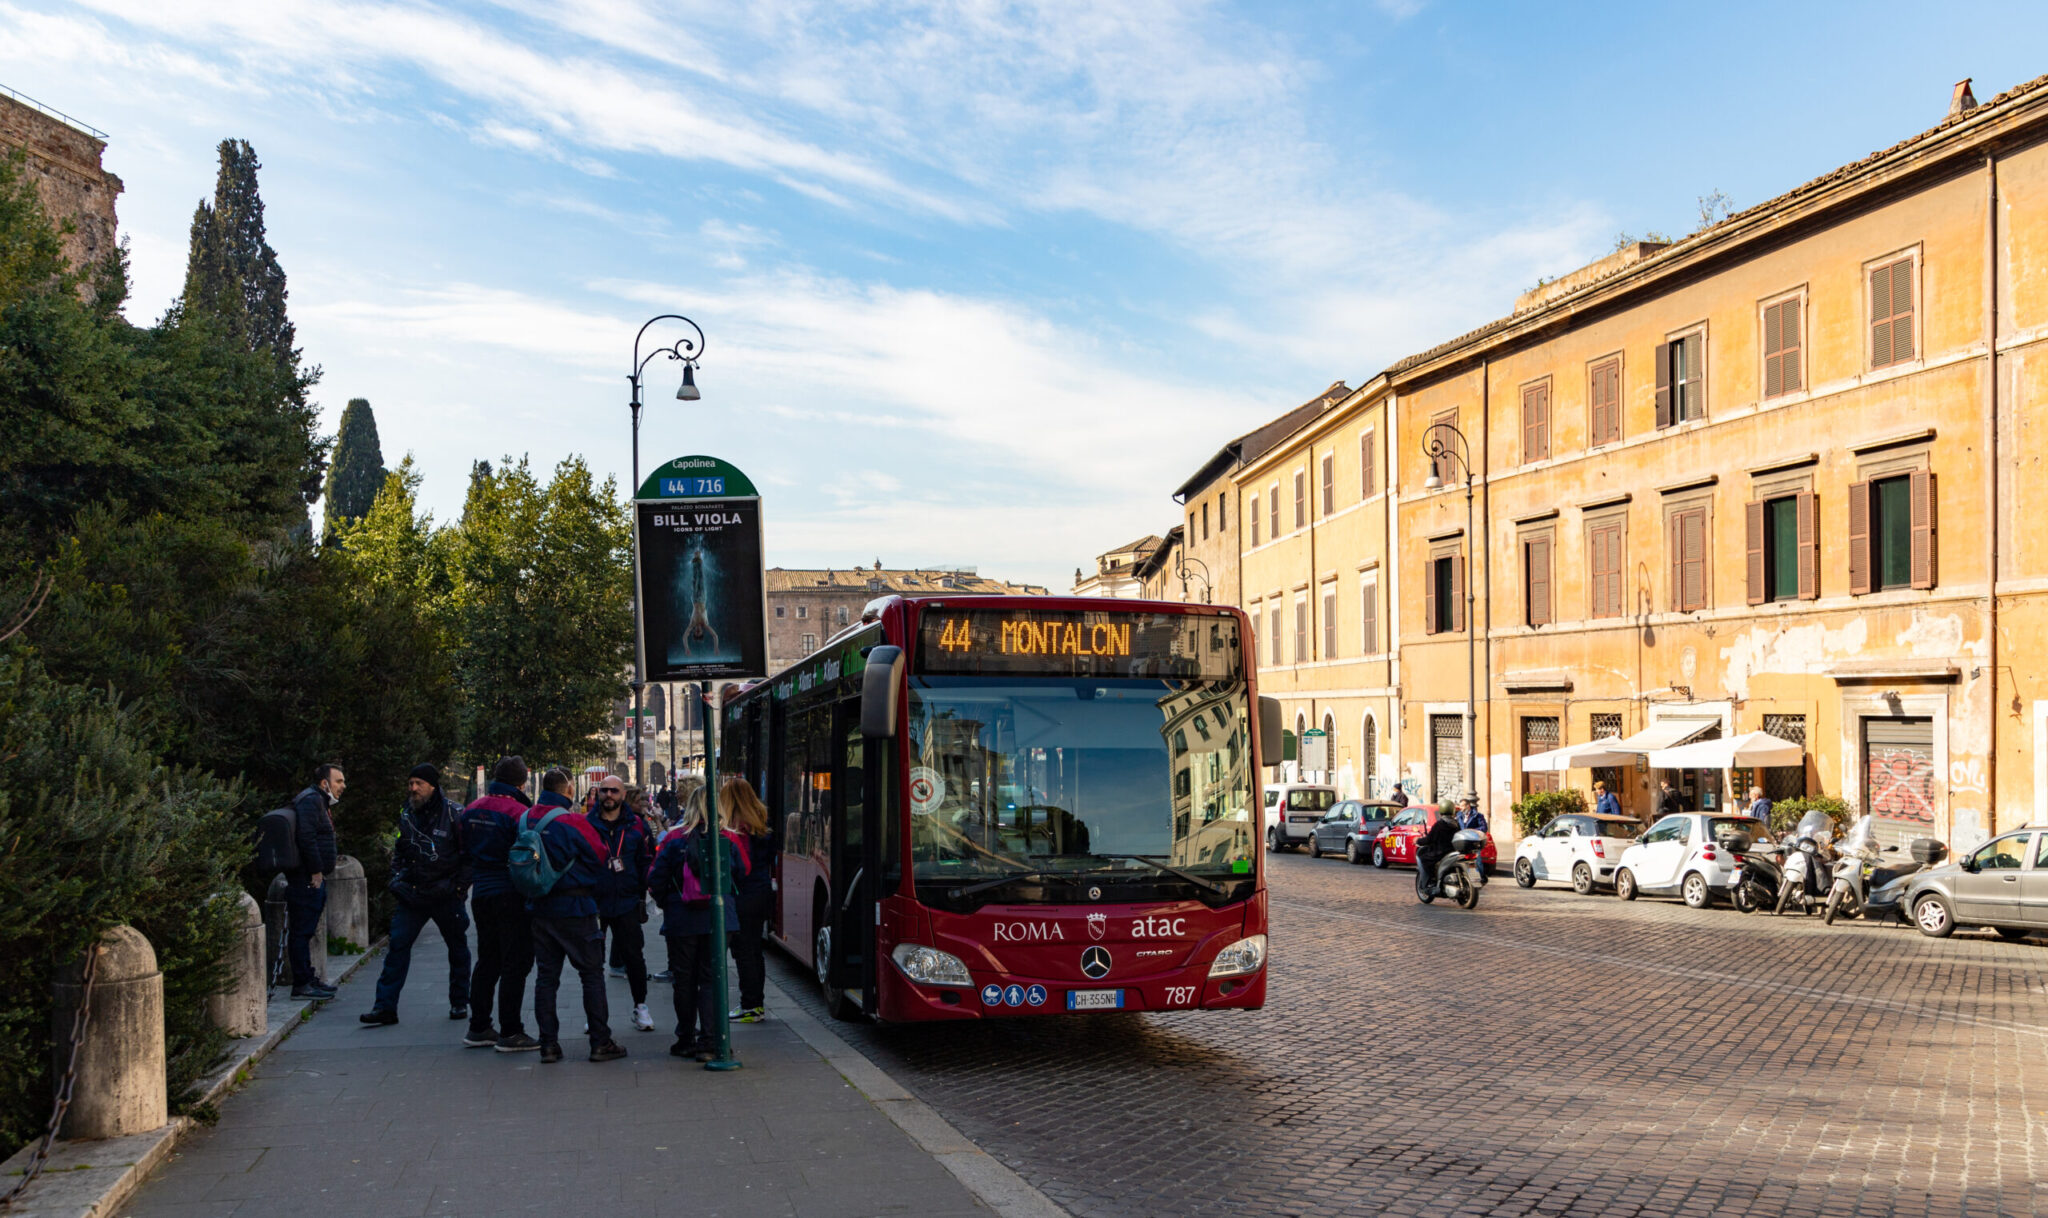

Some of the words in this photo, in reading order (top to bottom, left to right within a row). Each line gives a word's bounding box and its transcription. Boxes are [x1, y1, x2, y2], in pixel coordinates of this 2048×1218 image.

[672, 459, 716, 470] Capolinea
[668, 480, 685, 493] 44
[697, 479, 722, 493] 716
[653, 515, 688, 526] BILL
[694, 513, 742, 525] VIOLA
[940, 619, 972, 653] 44
[1001, 619, 1130, 655] MONTALCINI
[1384, 836, 1406, 855] enjoy
[993, 921, 1064, 941] ROMA
[1131, 915, 1186, 938] atac
[1136, 949, 1173, 957] CITARO
[1164, 986, 1196, 1005] 787
